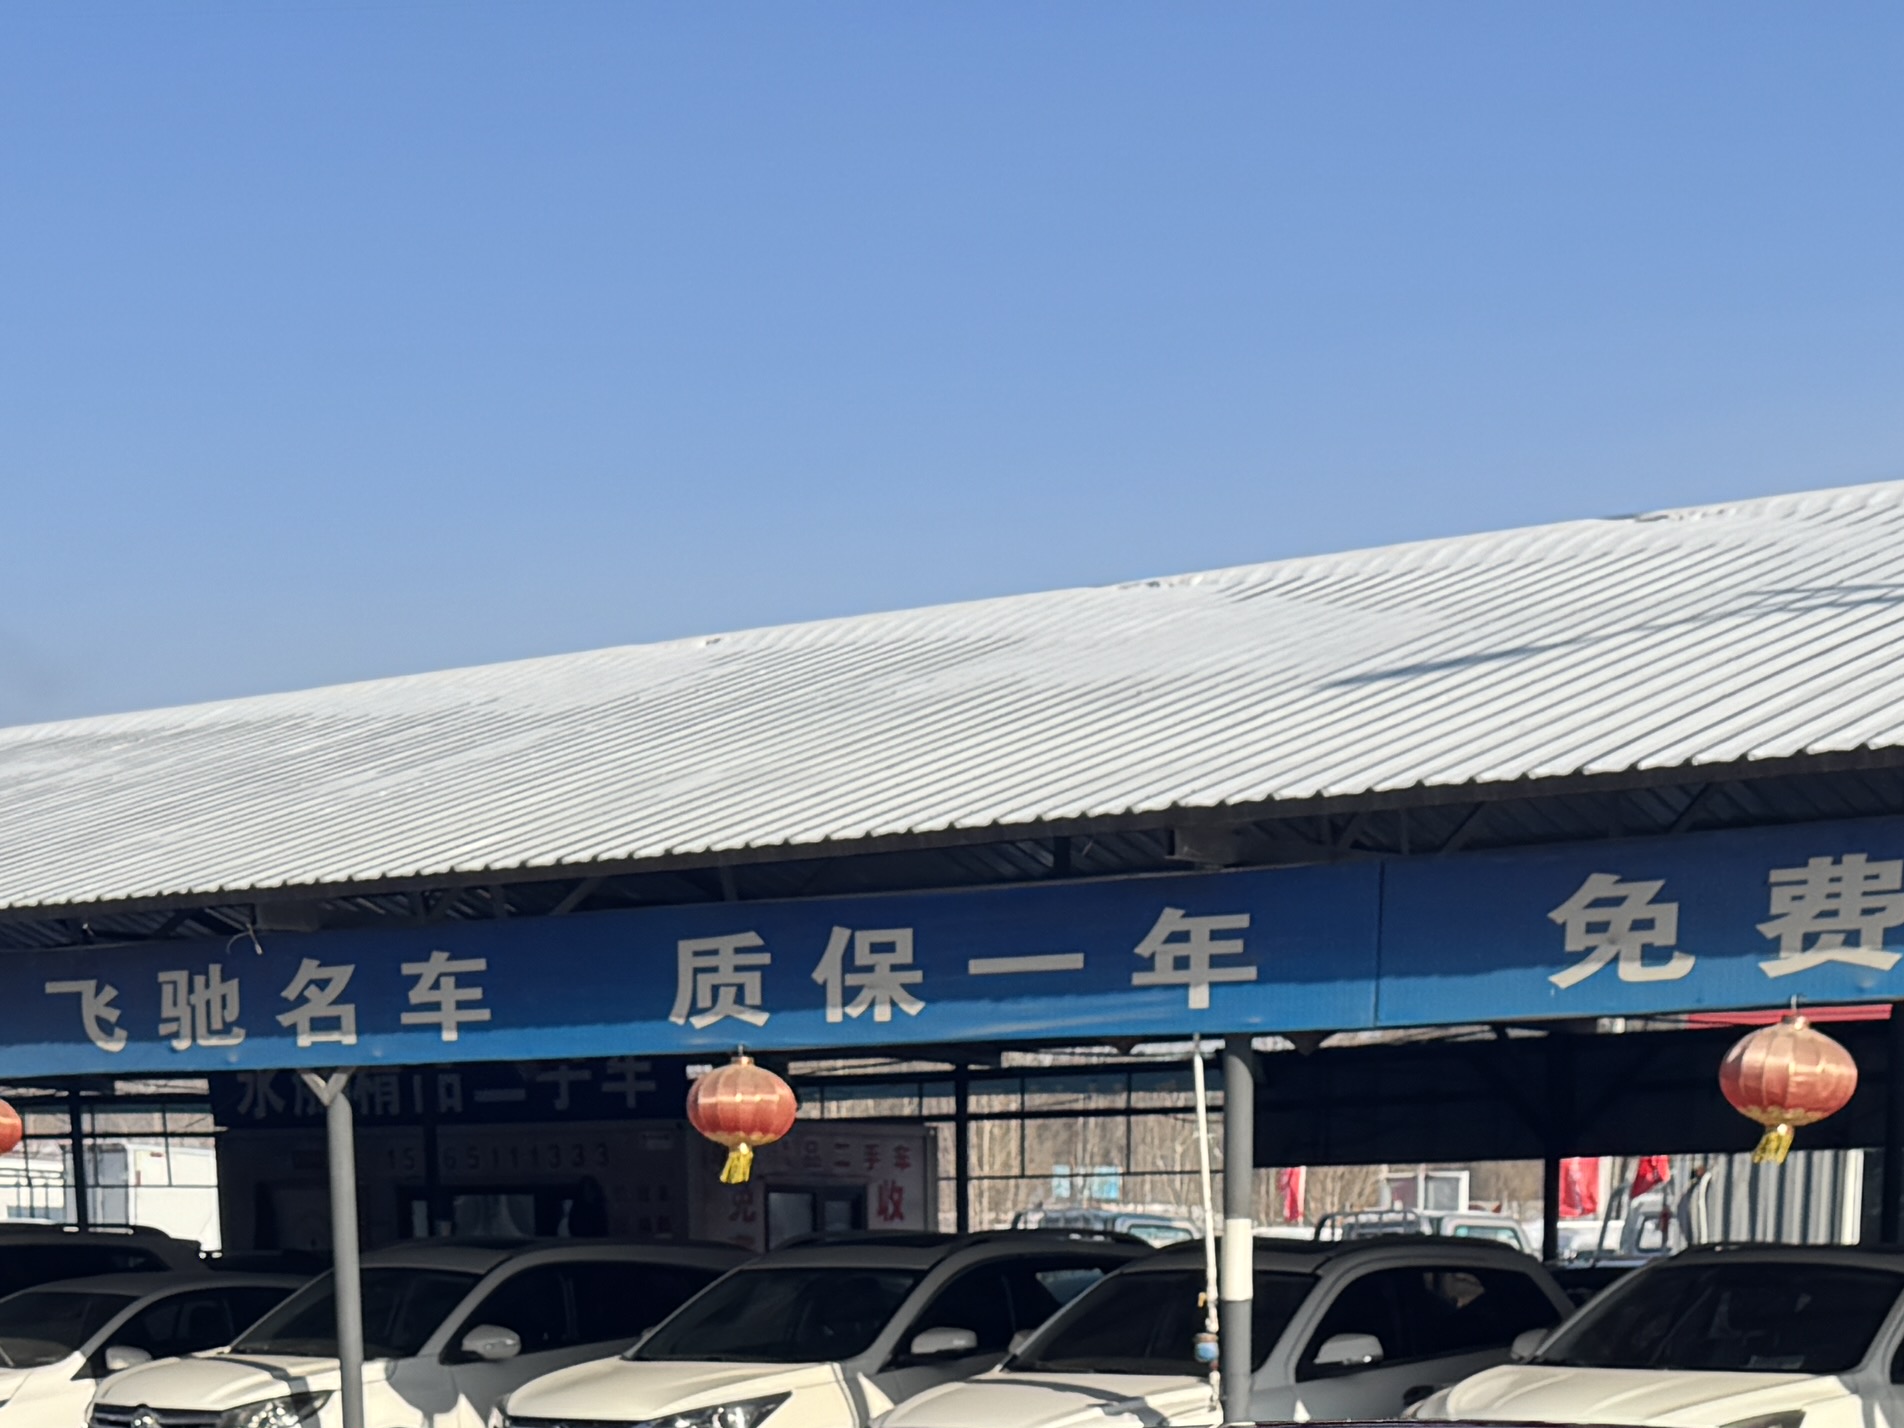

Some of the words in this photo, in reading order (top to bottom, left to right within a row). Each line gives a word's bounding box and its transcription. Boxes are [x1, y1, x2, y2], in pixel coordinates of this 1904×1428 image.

[44, 950, 492, 1052] 飞驰名车
[668, 906, 1258, 1030] 质保一年
[387, 1143, 610, 1171] 1565111333
